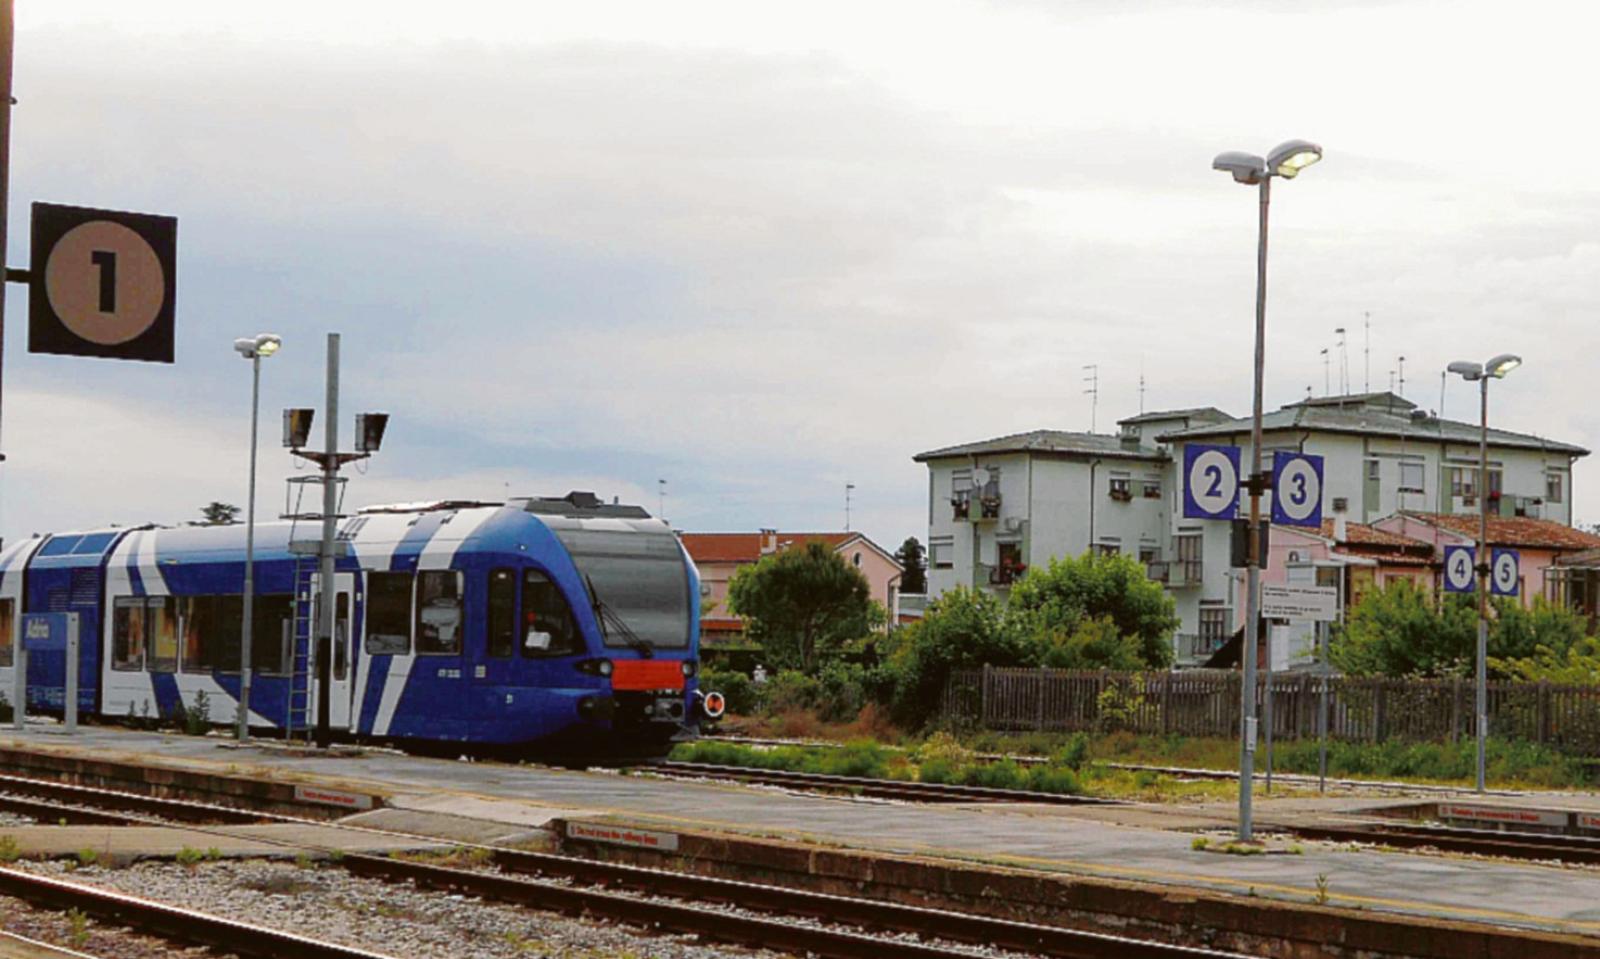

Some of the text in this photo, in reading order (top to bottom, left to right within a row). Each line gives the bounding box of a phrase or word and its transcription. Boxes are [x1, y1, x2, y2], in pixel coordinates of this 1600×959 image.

[91, 250, 117, 314] 1
[1204, 464, 1223, 497] 2
[1289, 471, 1307, 506] 3
[1454, 558, 1466, 579] 4
[1500, 562, 1511, 584] 5
